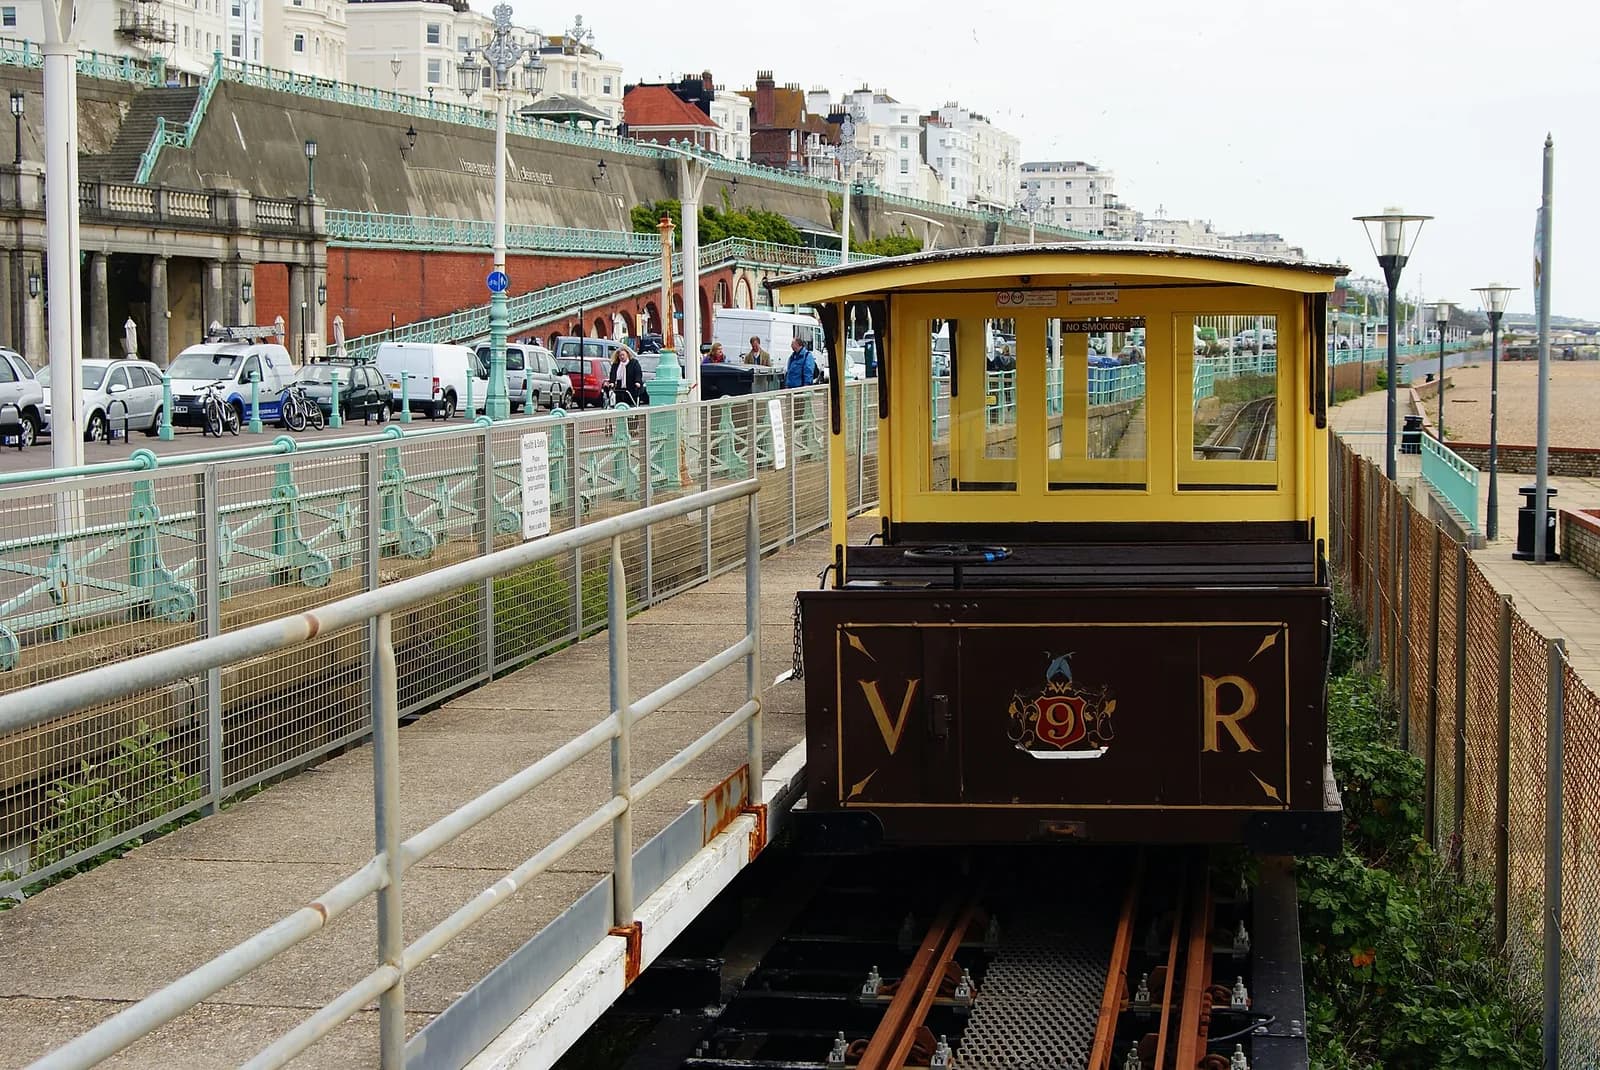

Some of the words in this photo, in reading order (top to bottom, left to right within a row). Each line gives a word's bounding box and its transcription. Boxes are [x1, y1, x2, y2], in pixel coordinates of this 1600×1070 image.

[1066, 323, 1080, 331] NO
[1082, 322, 1125, 331] SMOKING
[524, 440, 534, 450] Health
[537, 438, 546, 450] Safety
[857, 678, 921, 756] V
[1045, 702, 1076, 739] 9
[1200, 674, 1262, 753] R
